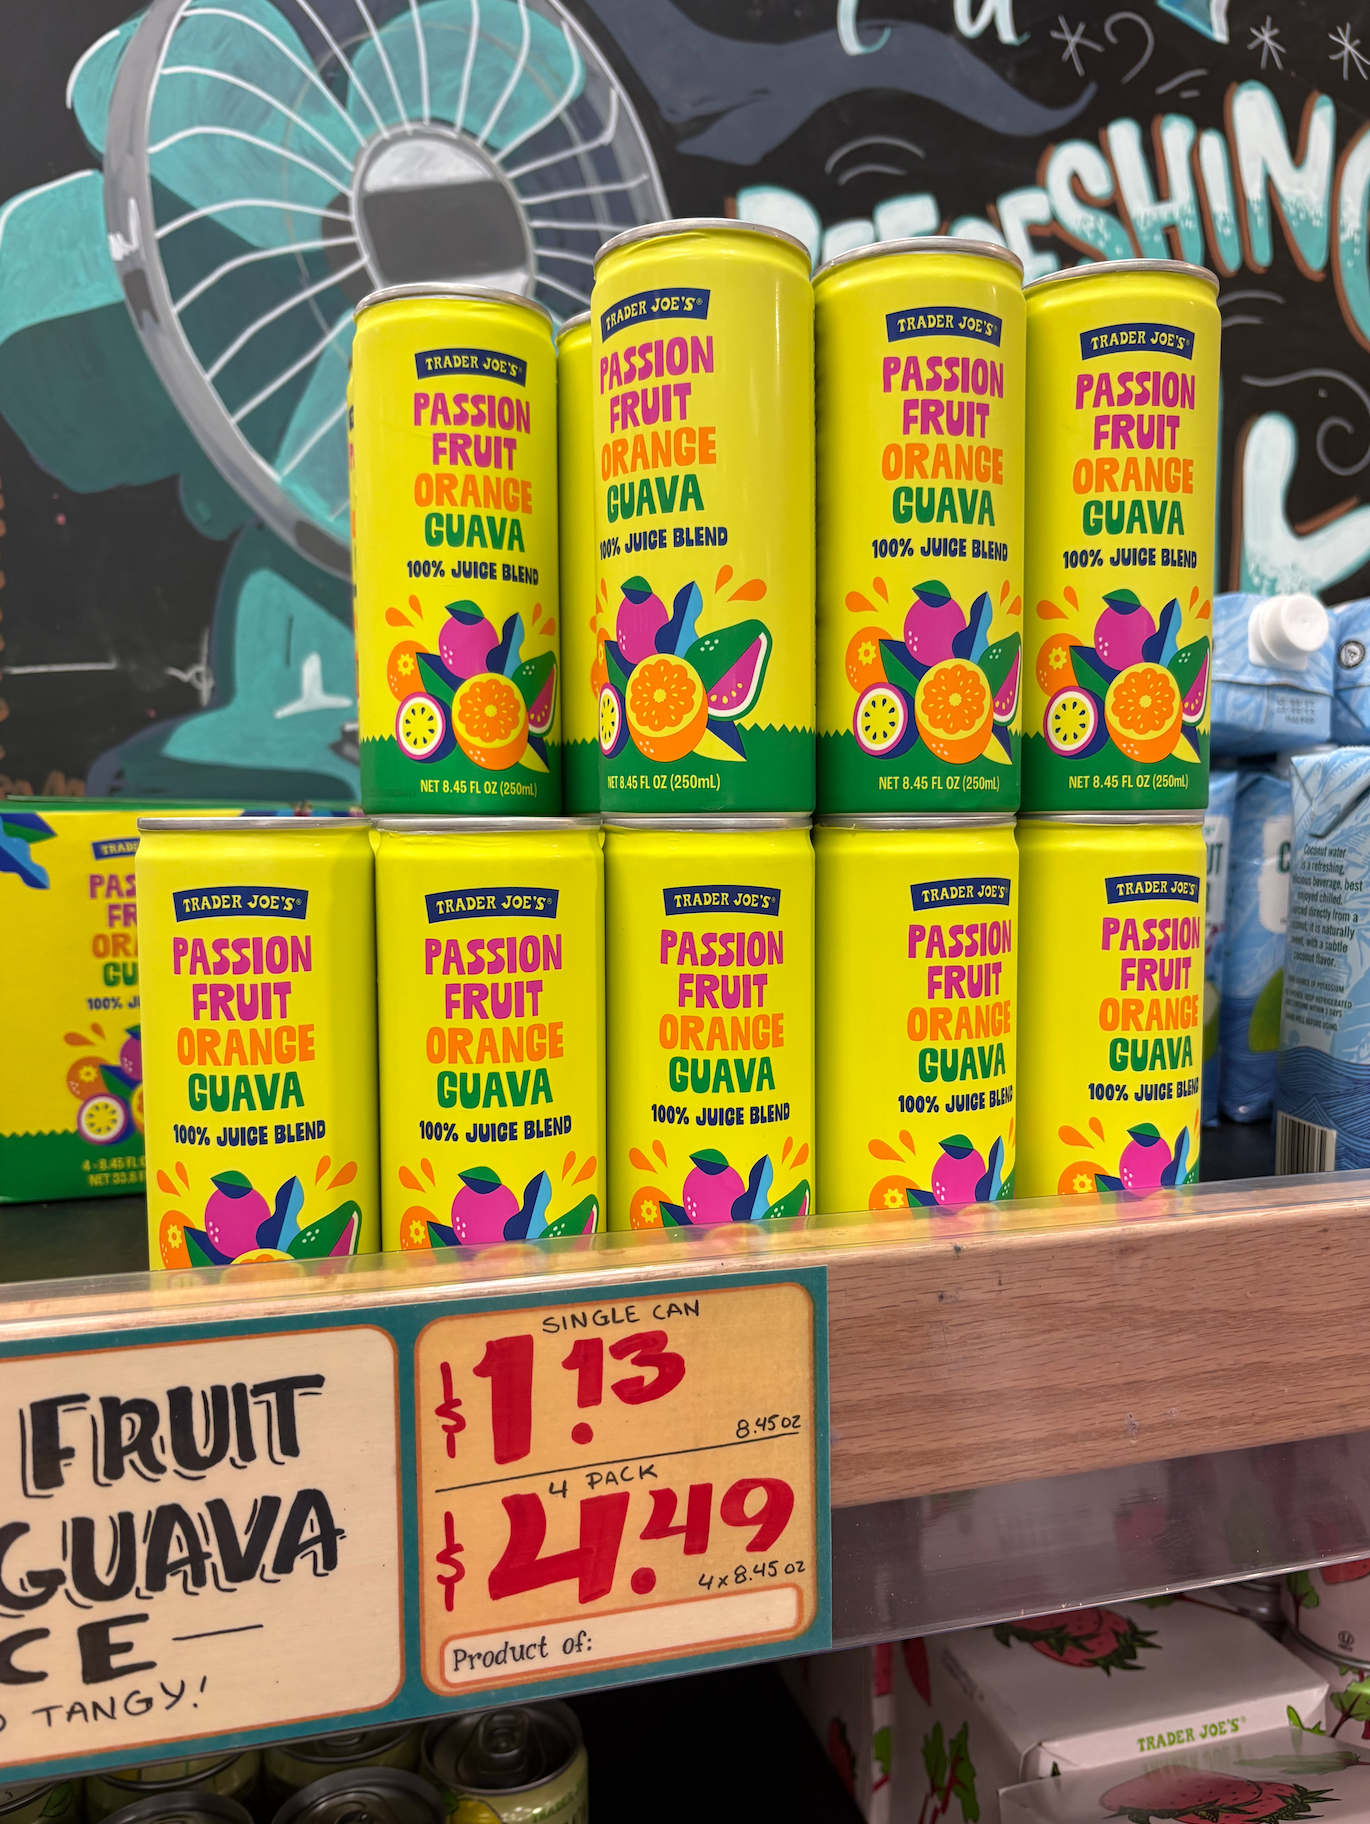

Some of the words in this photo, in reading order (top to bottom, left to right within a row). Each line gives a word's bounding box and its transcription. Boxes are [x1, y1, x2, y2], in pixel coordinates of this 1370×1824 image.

[605, 300, 647, 331] TRADER
[896, 314, 955, 333] TRADER
[1090, 330, 1147, 351] TRADER
[425, 355, 479, 371] TRADER
[600, 335, 714, 394] PASSION
[882, 356, 1004, 398] PASSION
[610, 382, 692, 433] FRUIT
[1075, 371, 1195, 410] PASSION
[414, 392, 530, 432] PASSION
[903, 399, 990, 438] FRUIT
[432, 432, 516, 469] FRUIT
[1094, 414, 1180, 450] FRUIT
[601, 426, 717, 482] ORANGE
[881, 442, 1004, 486] ORANGE
[413, 472, 533, 515] ORANGE
[1072, 456, 1194, 495] ORANGE
[606, 473, 705, 524] GUAVA
[892, 486, 995, 527] GUAVA
[424, 512, 525, 553] GUAVA
[1082, 499, 1185, 537] GUAVA
[599, 536, 621, 561] 100%
[624, 528, 667, 555] JUICE
[672, 526, 728, 548] BLEND
[871, 537, 915, 559] 100%
[920, 537, 967, 558] JUICE
[971, 539, 1008, 562] BLEND
[1062, 549, 1104, 569] 100%
[1109, 547, 1156, 567] JUICE
[1161, 548, 1197, 569] BLEND
[406, 559, 446, 578] 100%
[451, 560, 497, 580] JUICE
[501, 563, 539, 586] BLEND
[421, 779, 439, 793] NET
[443, 779, 466, 794] 8.45
[470, 780, 481, 794] FL
[484, 780, 497, 795] OZ
[500, 780, 537, 798] (250mL)
[608, 774, 618, 790] NET
[620, 774, 637, 790] 8.45
[640, 774, 650, 790] FL
[653, 773, 667, 790] OZ
[670, 772, 720, 792] (250mL)
[879, 776, 899, 790] NET
[903, 776, 928, 790] 8.45
[932, 776, 943, 790] FL
[946, 775, 960, 790] OZ
[963, 775, 999, 793] (250mL)
[1069, 775, 1090, 789] NET
[1093, 774, 1118, 789] 8.45
[1122, 774, 1133, 788] FL
[1136, 774, 1150, 788] OZ
[1153, 773, 1188, 790] (250mL)
[1304, 843, 1327, 857] Coconut
[1328, 846, 1347, 859] water
[182, 894, 243, 913] TRADER
[673, 892, 730, 908] TRADER
[921, 885, 975, 903] TRADER
[1115, 880, 1168, 897] TRADER
[1345, 878, 1363, 892] best
[435, 895, 497, 915] TRADER
[1333, 909, 1350, 923] from
[1352, 913, 1359, 923] a
[660, 929, 783, 967] PASSION
[908, 920, 1011, 959] PASSION
[1102, 917, 1200, 951] PASSION
[1321, 922, 1355, 940] naturally
[1325, 939, 1348, 953] subtle
[173, 935, 312, 975] PASSION
[425, 934, 562, 975] PASSION
[678, 973, 768, 1009] FRUIT
[927, 961, 1002, 1000] FRUIT
[1120, 956, 1192, 991] FRUIT
[87, 997, 122, 1010] 100%
[192, 981, 292, 1021] FRUIT
[445, 979, 543, 1020] FRUIT
[1098, 993, 1199, 1032] ORANGE
[658, 1012, 785, 1052] ORANGE
[906, 999, 1011, 1042] ORANGE
[176, 1023, 316, 1067] ORANGE
[425, 1020, 564, 1065] ORANGE
[1109, 1035, 1193, 1072] GUAVA
[668, 1056, 776, 1094] GUAVA
[918, 1042, 1006, 1083] GUAVA
[187, 1071, 305, 1113] GUAVA
[436, 1067, 554, 1110] GUAVA
[897, 1094, 940, 1114] 100%
[945, 1091, 986, 1113] JUICE
[1088, 1082, 1129, 1102] 100%
[1134, 1082, 1173, 1102] JUICE
[173, 1123, 211, 1146] 100%
[216, 1125, 269, 1147] JUICE
[274, 1119, 326, 1145] BLEND
[419, 1120, 459, 1142] 100%
[465, 1121, 518, 1143] JUICE
[523, 1114, 572, 1140] BLEND
[651, 1103, 690, 1125] 100%
[695, 1106, 745, 1127] JUICE
[749, 1102, 790, 1125] BLEND
[542, 1305, 640, 1334] SINGLE
[652, 1300, 700, 1321] CAN
[20, 1374, 325, 1498] FRUIT
[549, 1480, 568, 1498] 4
[586, 1464, 658, 1490] PACK
[0, 1488, 346, 1617] GUAVA
[453, 1636, 548, 1672] Product
[562, 1632, 593, 1655] of:
[32, 1675, 206, 1727] TANGY!
[1137, 1728, 1195, 1753] TRADER
